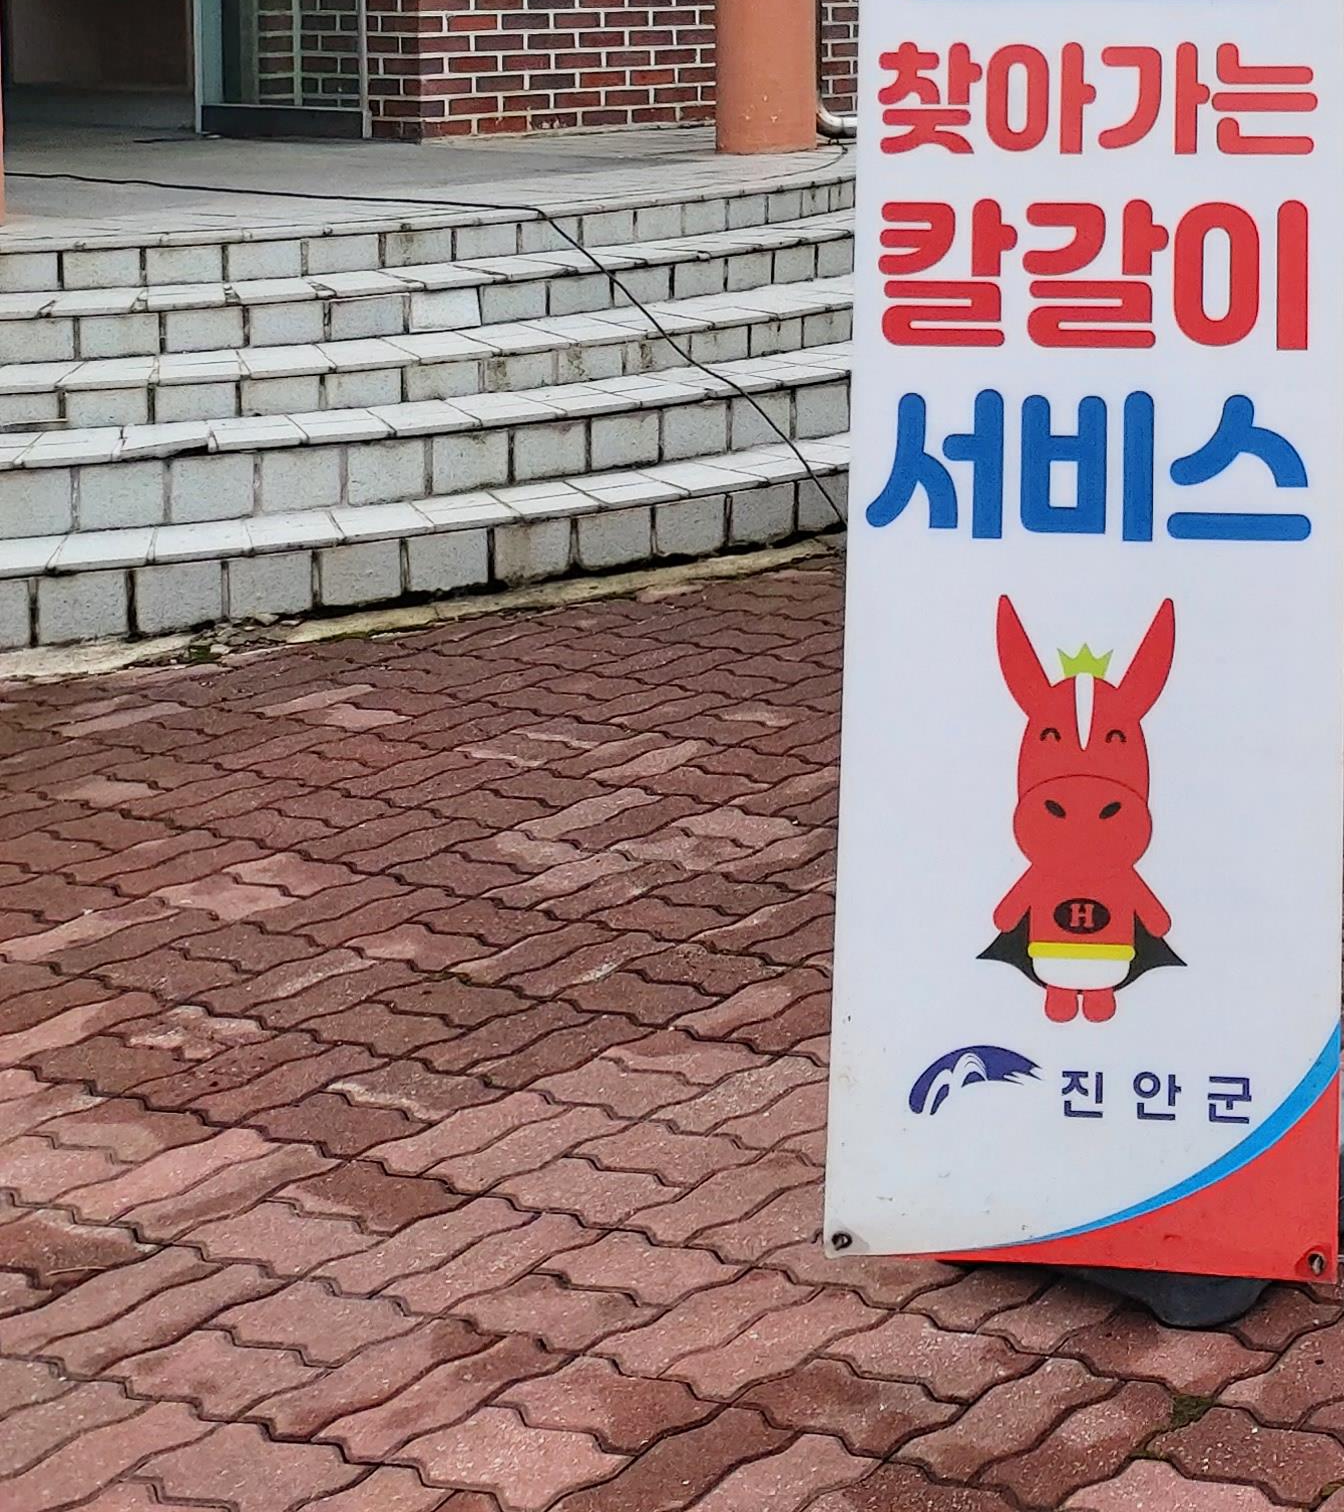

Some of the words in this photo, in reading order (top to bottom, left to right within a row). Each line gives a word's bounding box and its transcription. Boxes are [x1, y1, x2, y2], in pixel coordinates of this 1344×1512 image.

[877, 41, 1319, 155] 찾아가는
[877, 198, 1309, 351] 칼갈이
[865, 388, 1311, 542] 서비스
[1070, 903, 1095, 927] H
